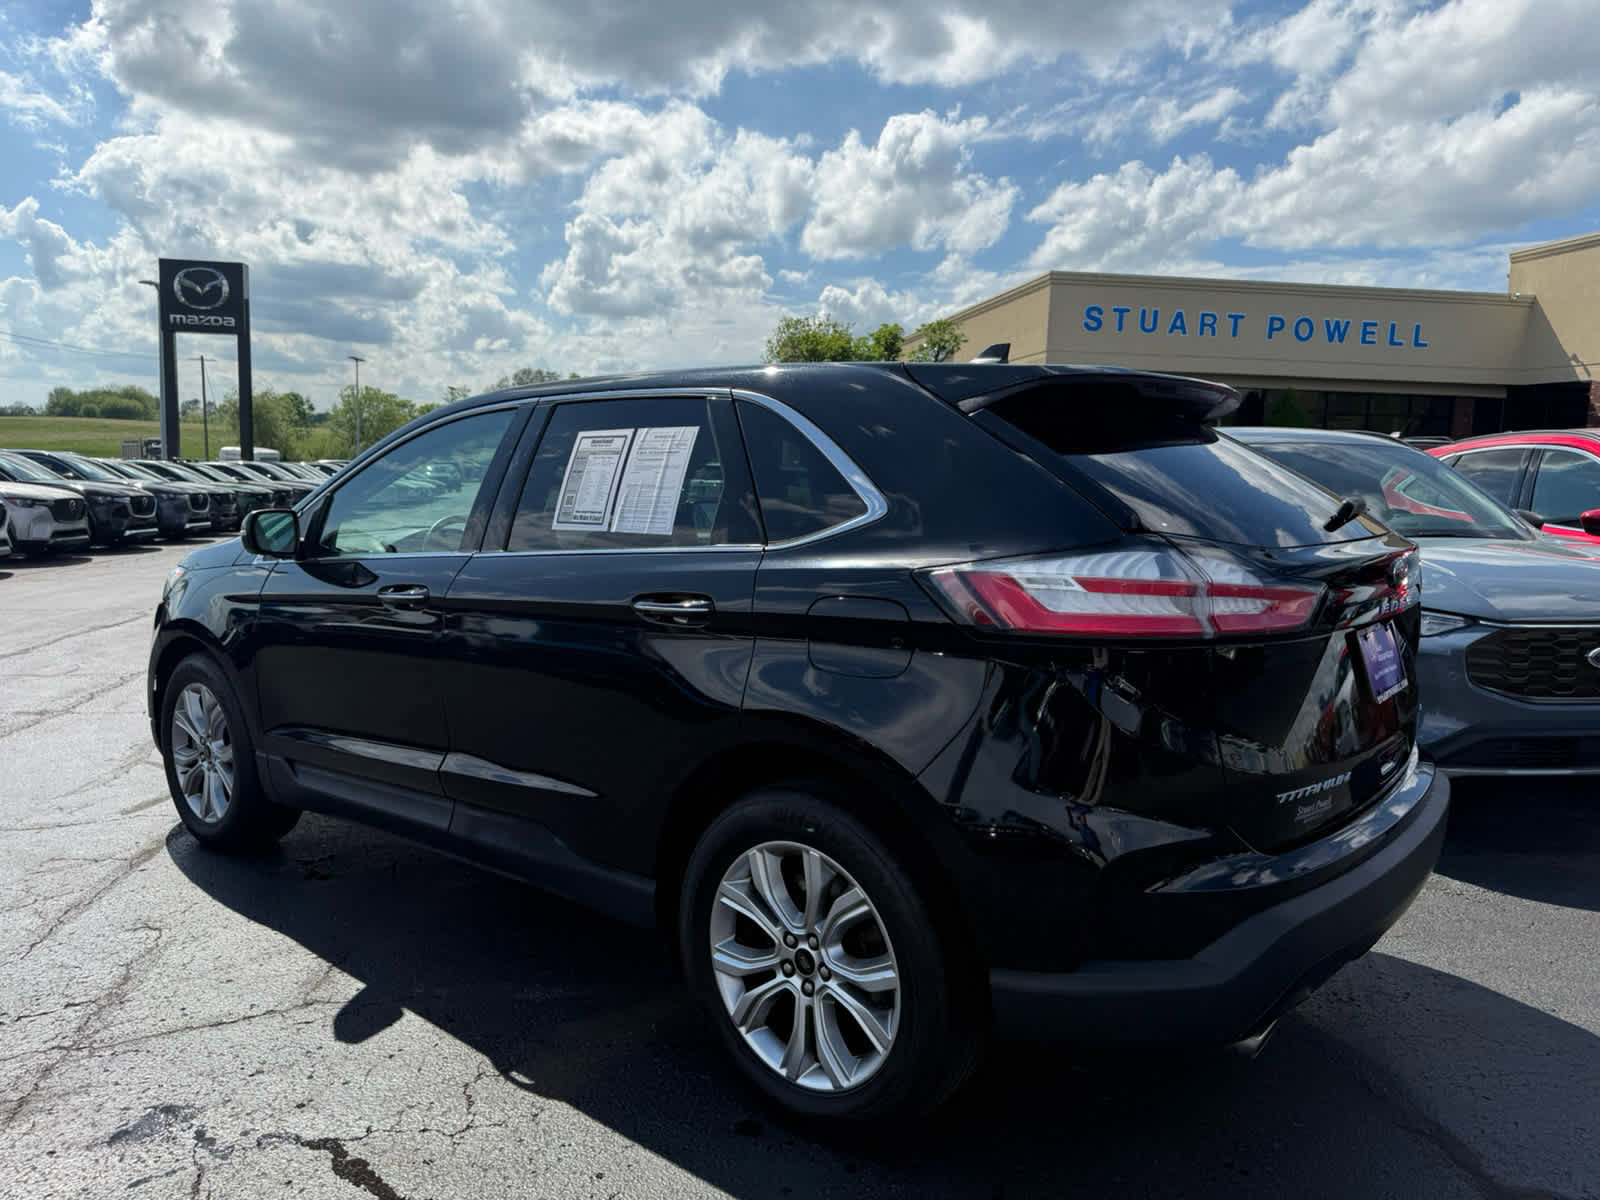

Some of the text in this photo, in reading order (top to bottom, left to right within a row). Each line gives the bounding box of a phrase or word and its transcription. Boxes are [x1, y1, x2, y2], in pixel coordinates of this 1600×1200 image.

[169, 314, 235, 327] mazda
[1083, 304, 1429, 349] STUART POWELL
